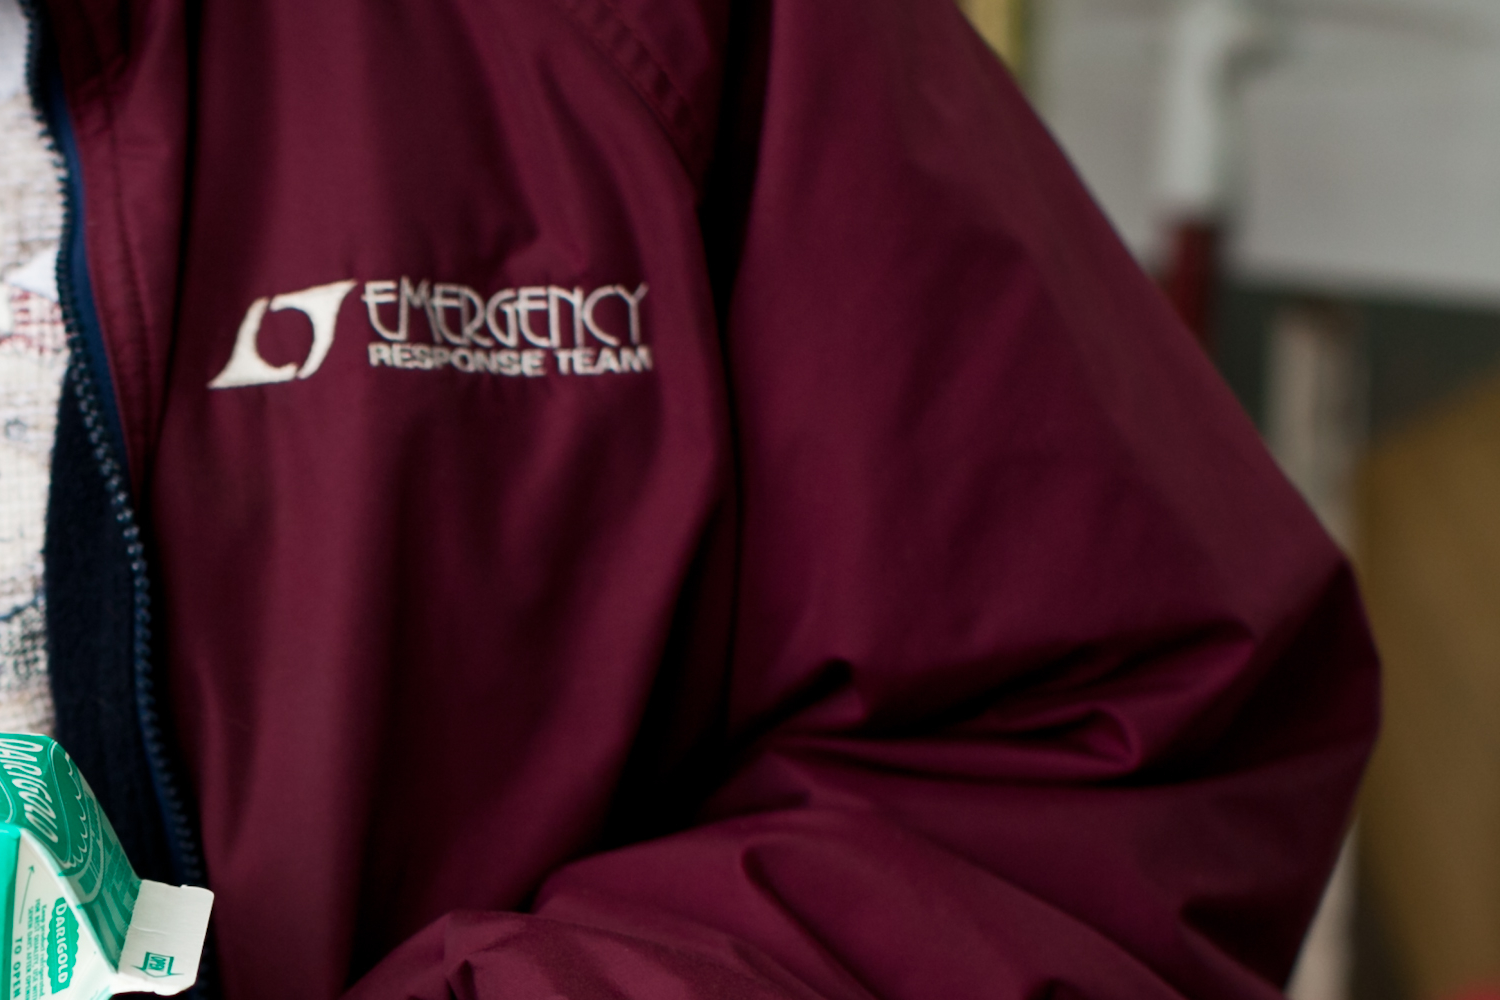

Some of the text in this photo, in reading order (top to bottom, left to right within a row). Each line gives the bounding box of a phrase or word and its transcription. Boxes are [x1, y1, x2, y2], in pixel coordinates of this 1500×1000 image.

[361, 276, 649, 348] EMERGENCY
[369, 342, 653, 377] RESPONSE TEAM
[13, 936, 22, 999] TO OPEN
[55, 902, 68, 984] DARIGOLD
[149, 956, 167, 972] OPEN
